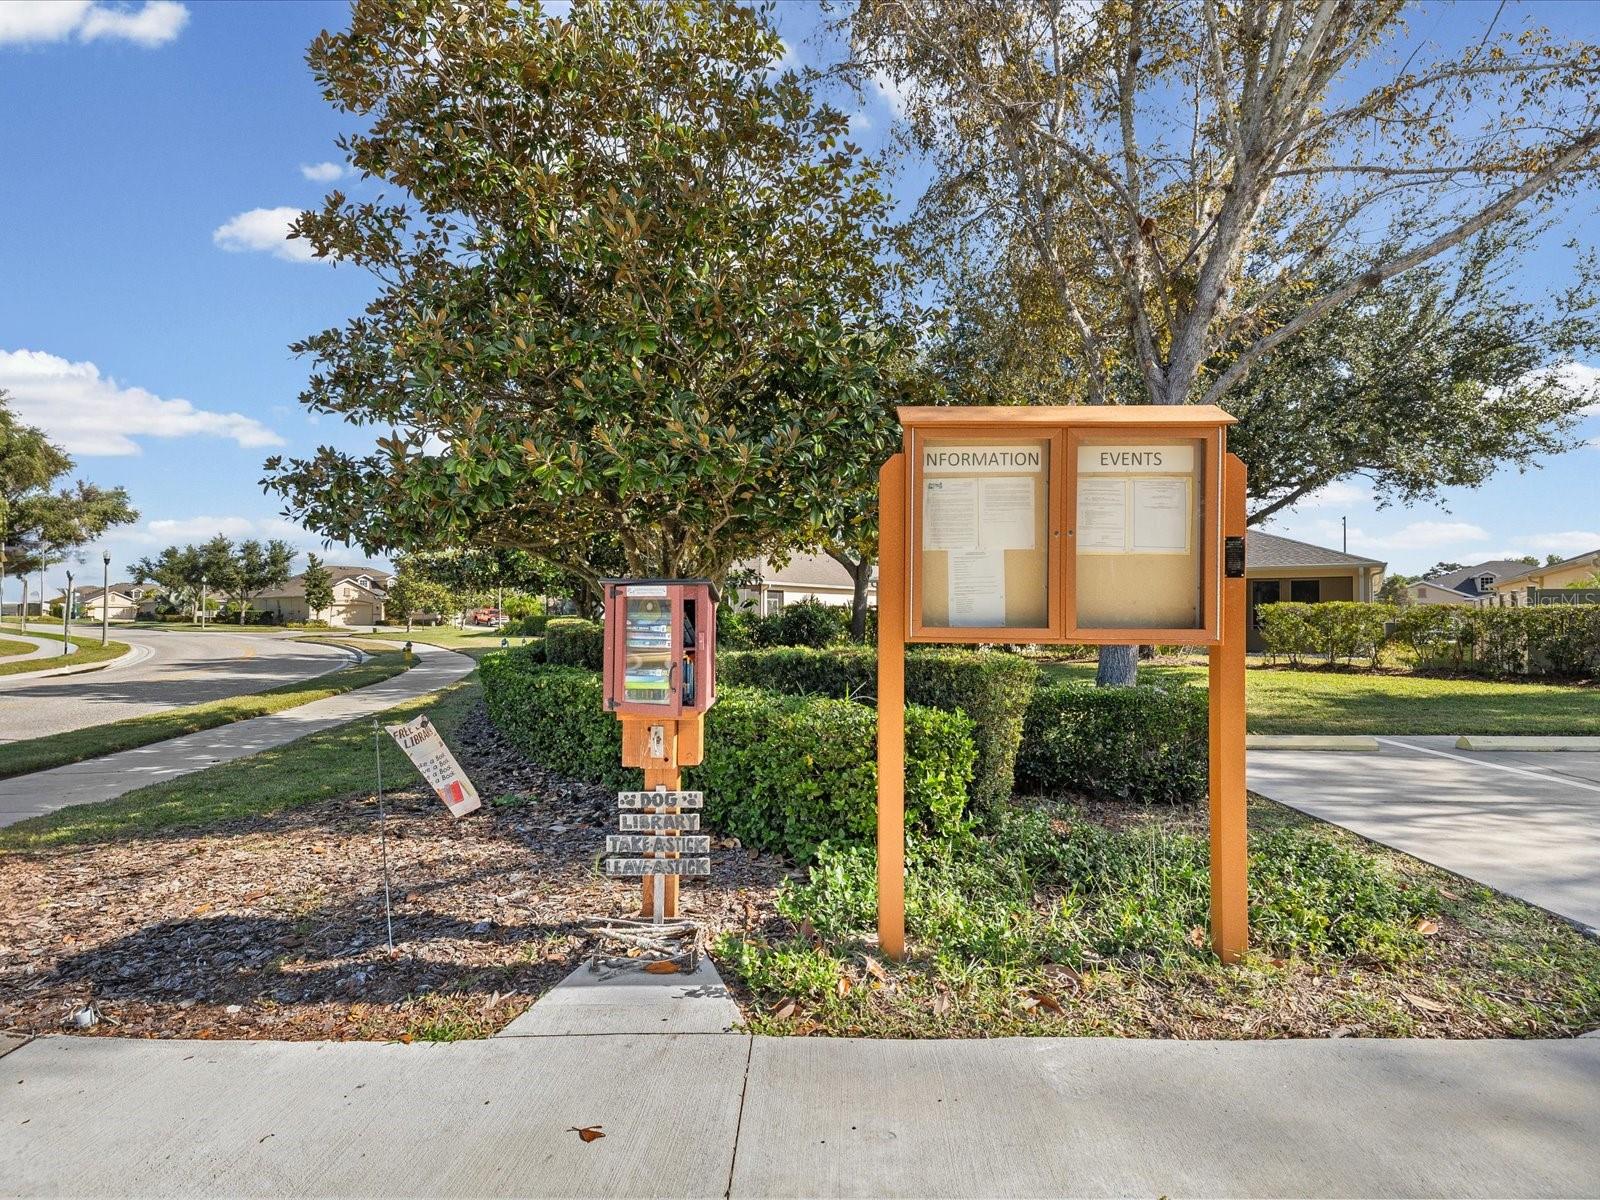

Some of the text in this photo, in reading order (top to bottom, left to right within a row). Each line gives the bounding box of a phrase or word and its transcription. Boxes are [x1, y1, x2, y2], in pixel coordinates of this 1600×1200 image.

[1100, 452, 1163, 466] EVENTS
[640, 793, 678, 807] DOG
[621, 814, 698, 830] LIBRARY
